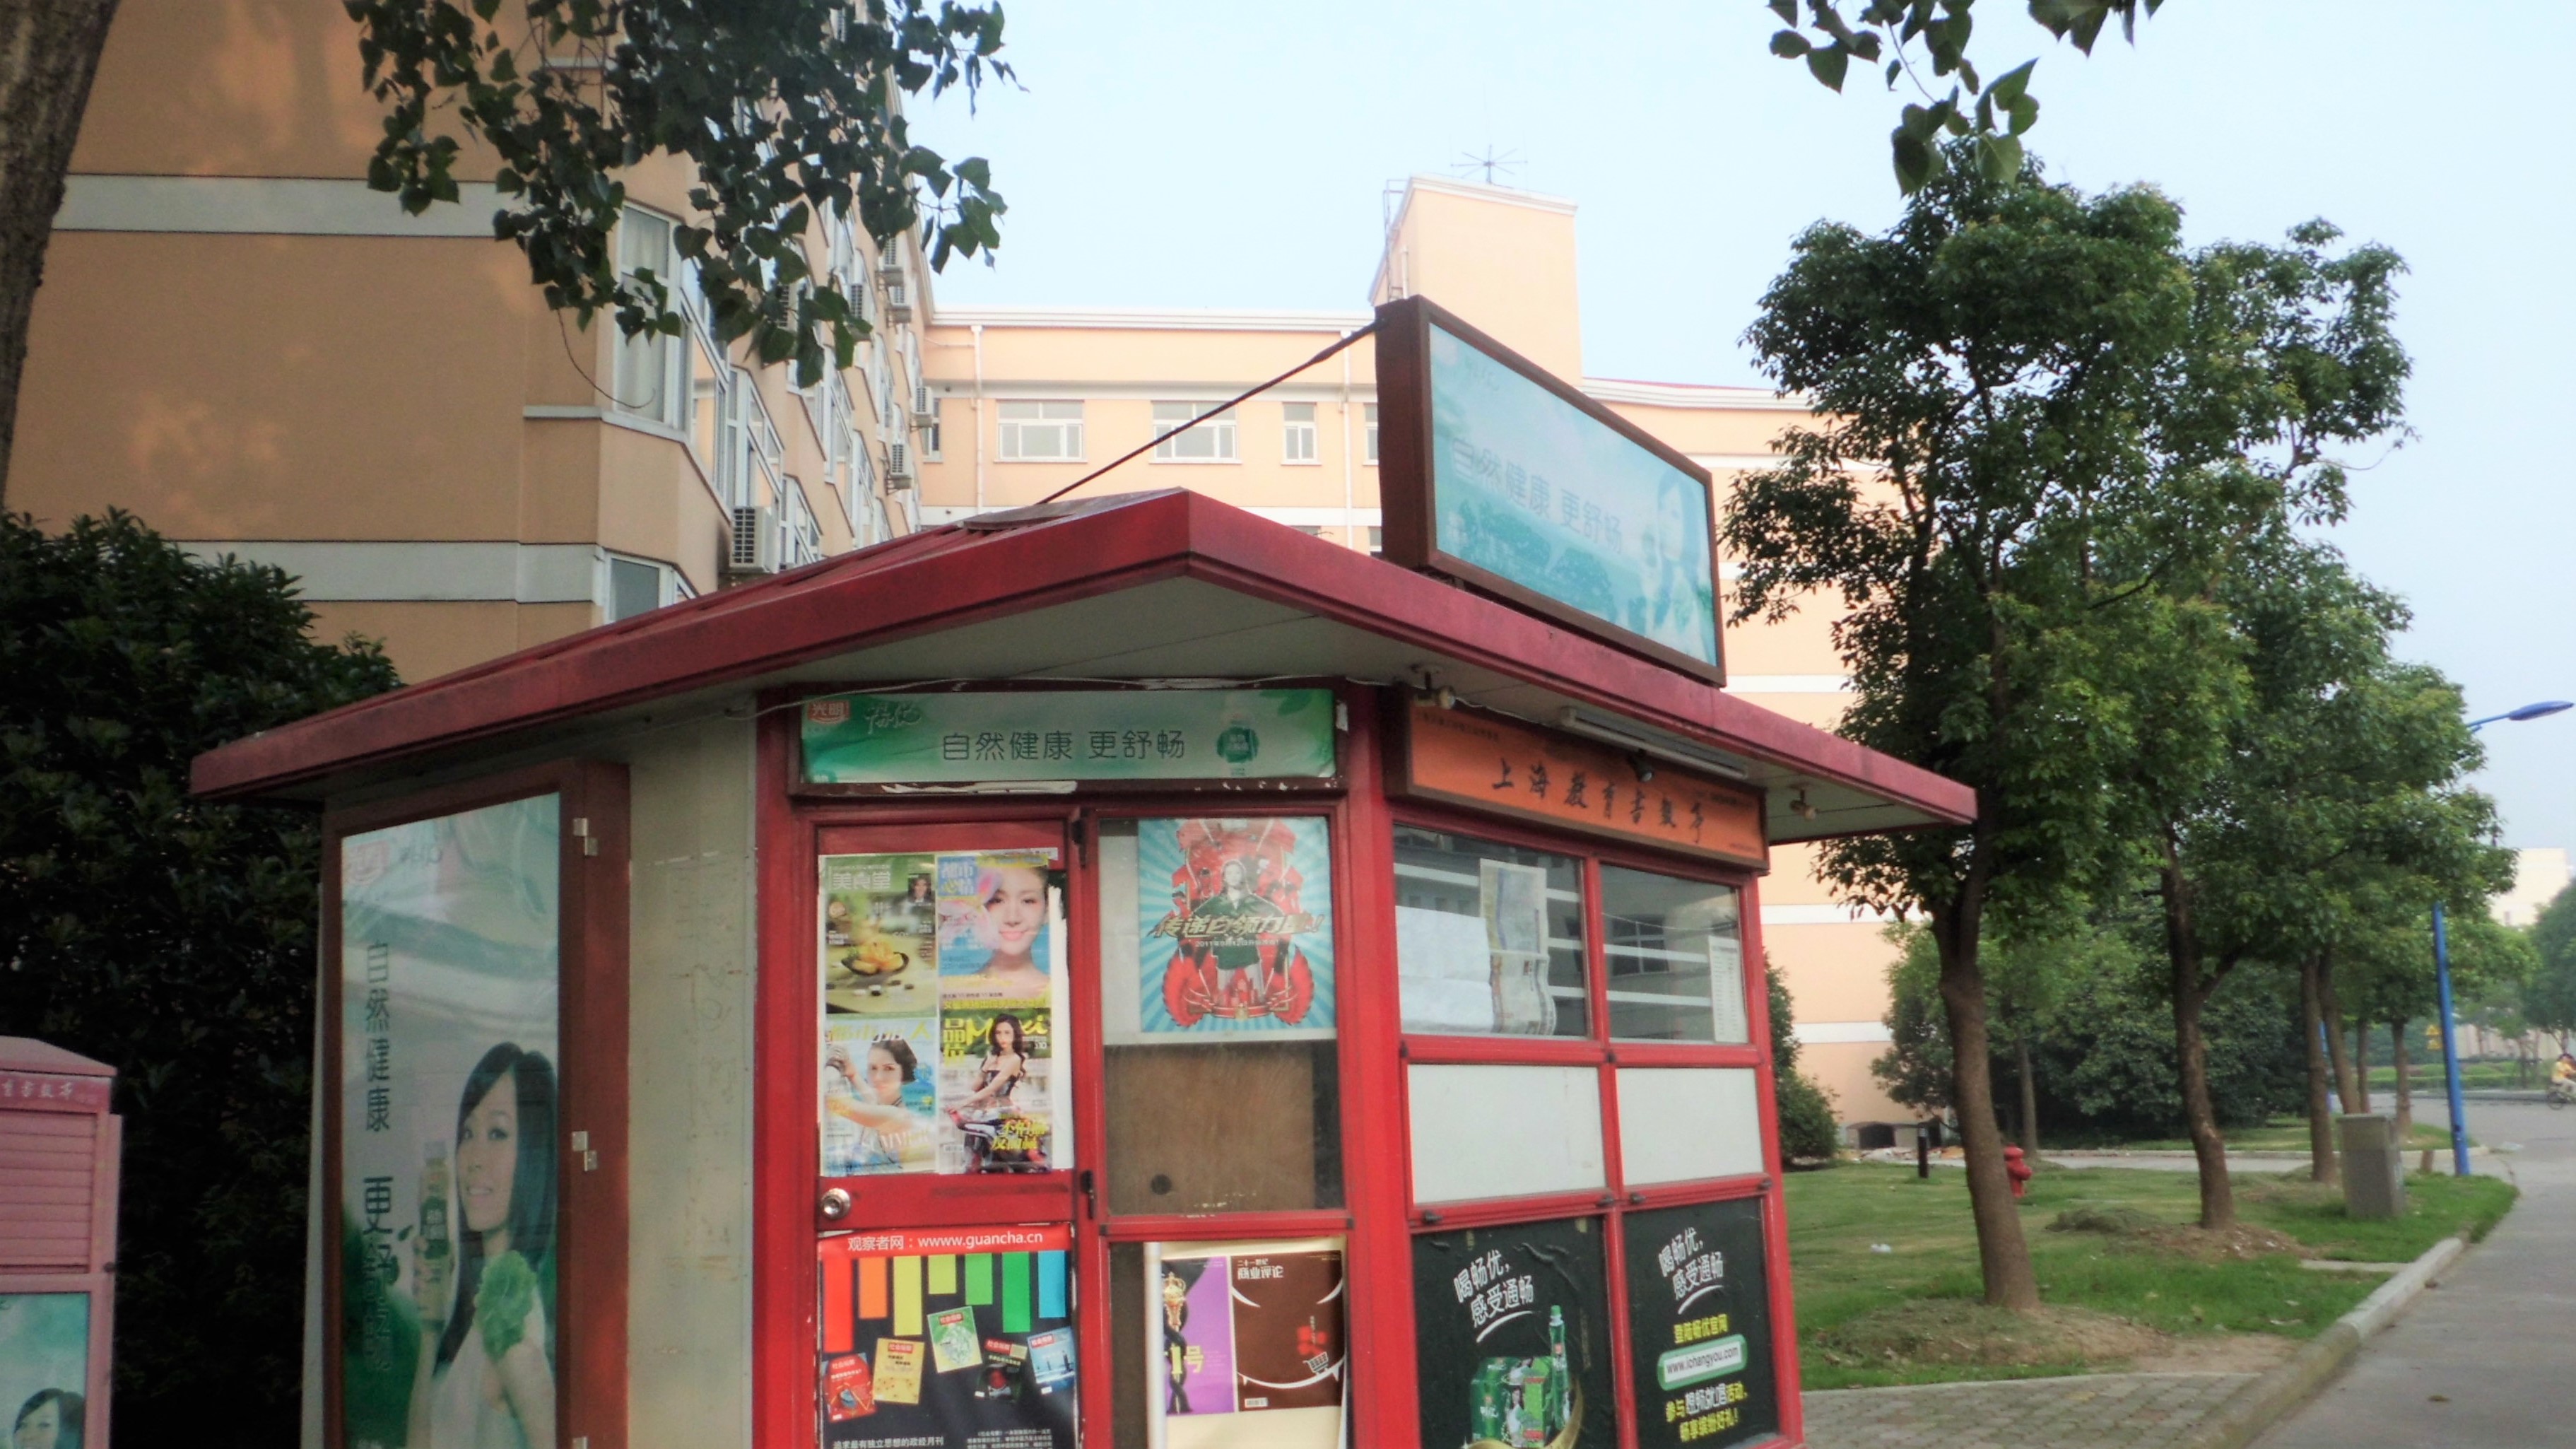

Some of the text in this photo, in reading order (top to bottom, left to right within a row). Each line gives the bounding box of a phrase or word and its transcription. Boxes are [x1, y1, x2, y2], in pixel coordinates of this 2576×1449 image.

[1451, 438, 1623, 555] 自然健康 更舒畅
[942, 729, 1187, 761] 自然健康 更舒畅
[365, 941, 392, 1132] 自然健康
[1237, 1265, 1284, 1281] 商业评论
[1672, 1251, 1724, 1301] 感受通畅
[1470, 1274, 1534, 1328] 感受通畅
